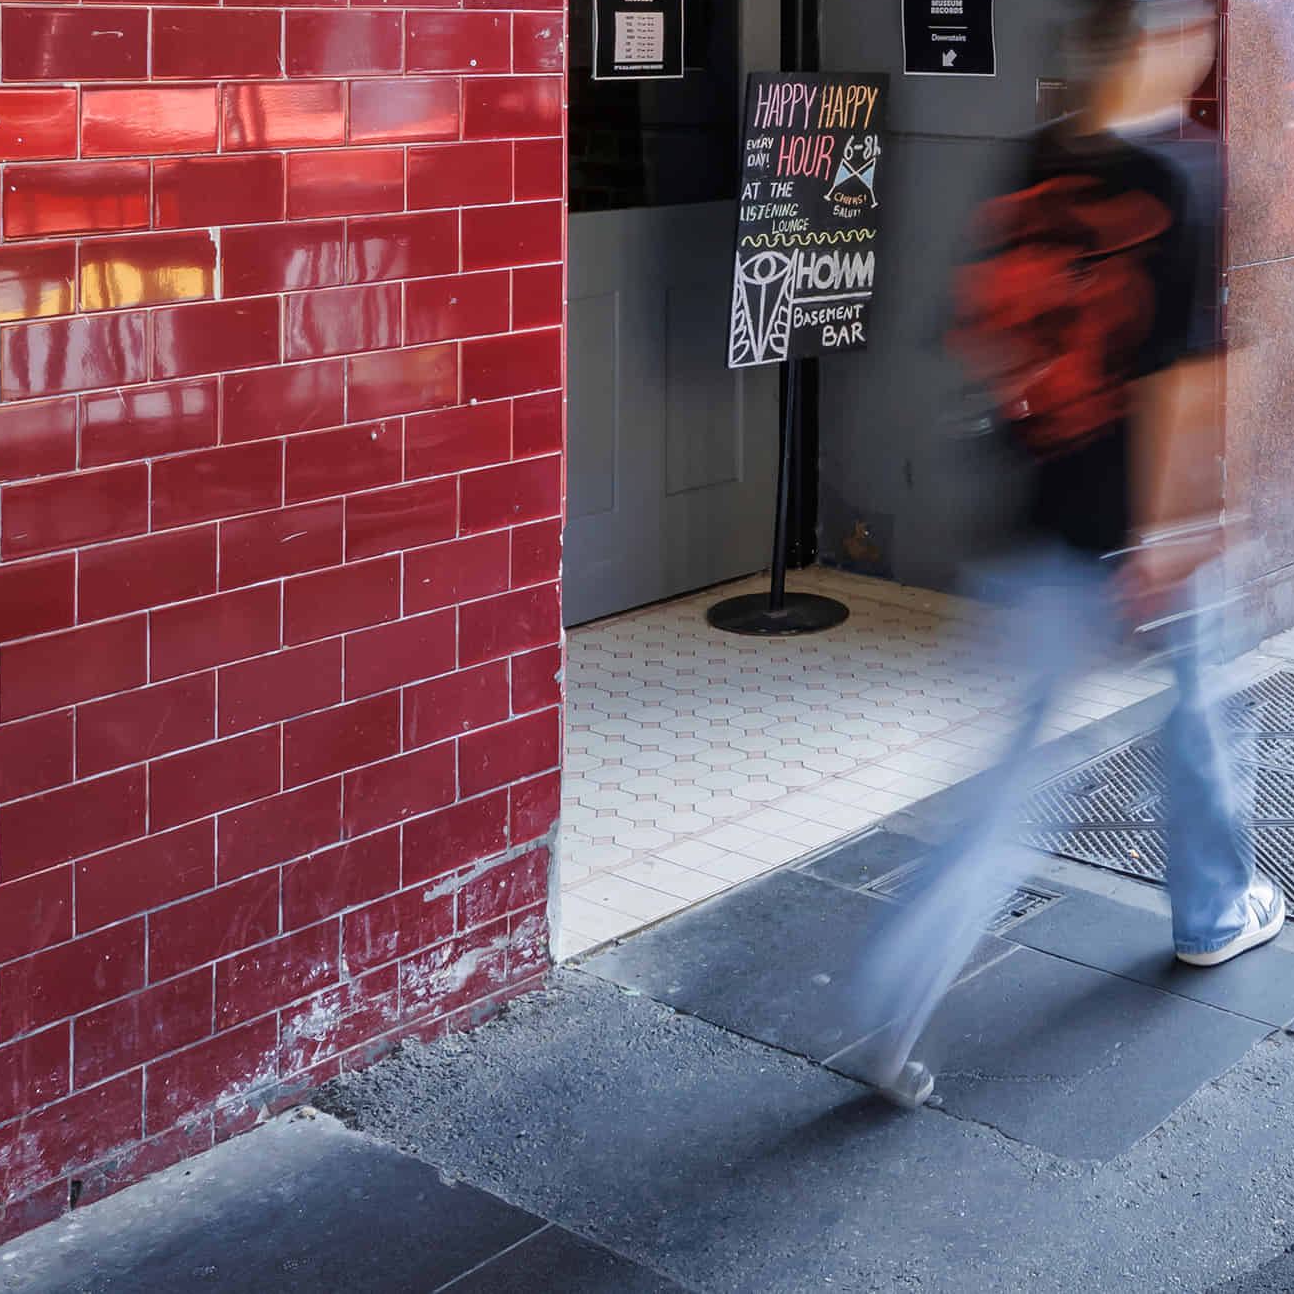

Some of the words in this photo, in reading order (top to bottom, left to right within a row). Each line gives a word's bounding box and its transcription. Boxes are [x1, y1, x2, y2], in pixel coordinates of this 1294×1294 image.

[754, 82, 818, 131] HAPPY
[818, 84, 880, 130] HAPPY
[746, 136, 774, 151] EVERY
[843, 133, 882, 161] 6-8h
[746, 153, 770, 169] DAY!
[776, 134, 835, 181] HOUR
[741, 181, 762, 201] AT
[770, 181, 795, 199] THE
[739, 202, 799, 222] LISTENING
[771, 217, 810, 235] LOUNGE
[795, 250, 875, 290] HOWM
[793, 304, 864, 329] BASEMENT
[821, 323, 866, 347] BAR
